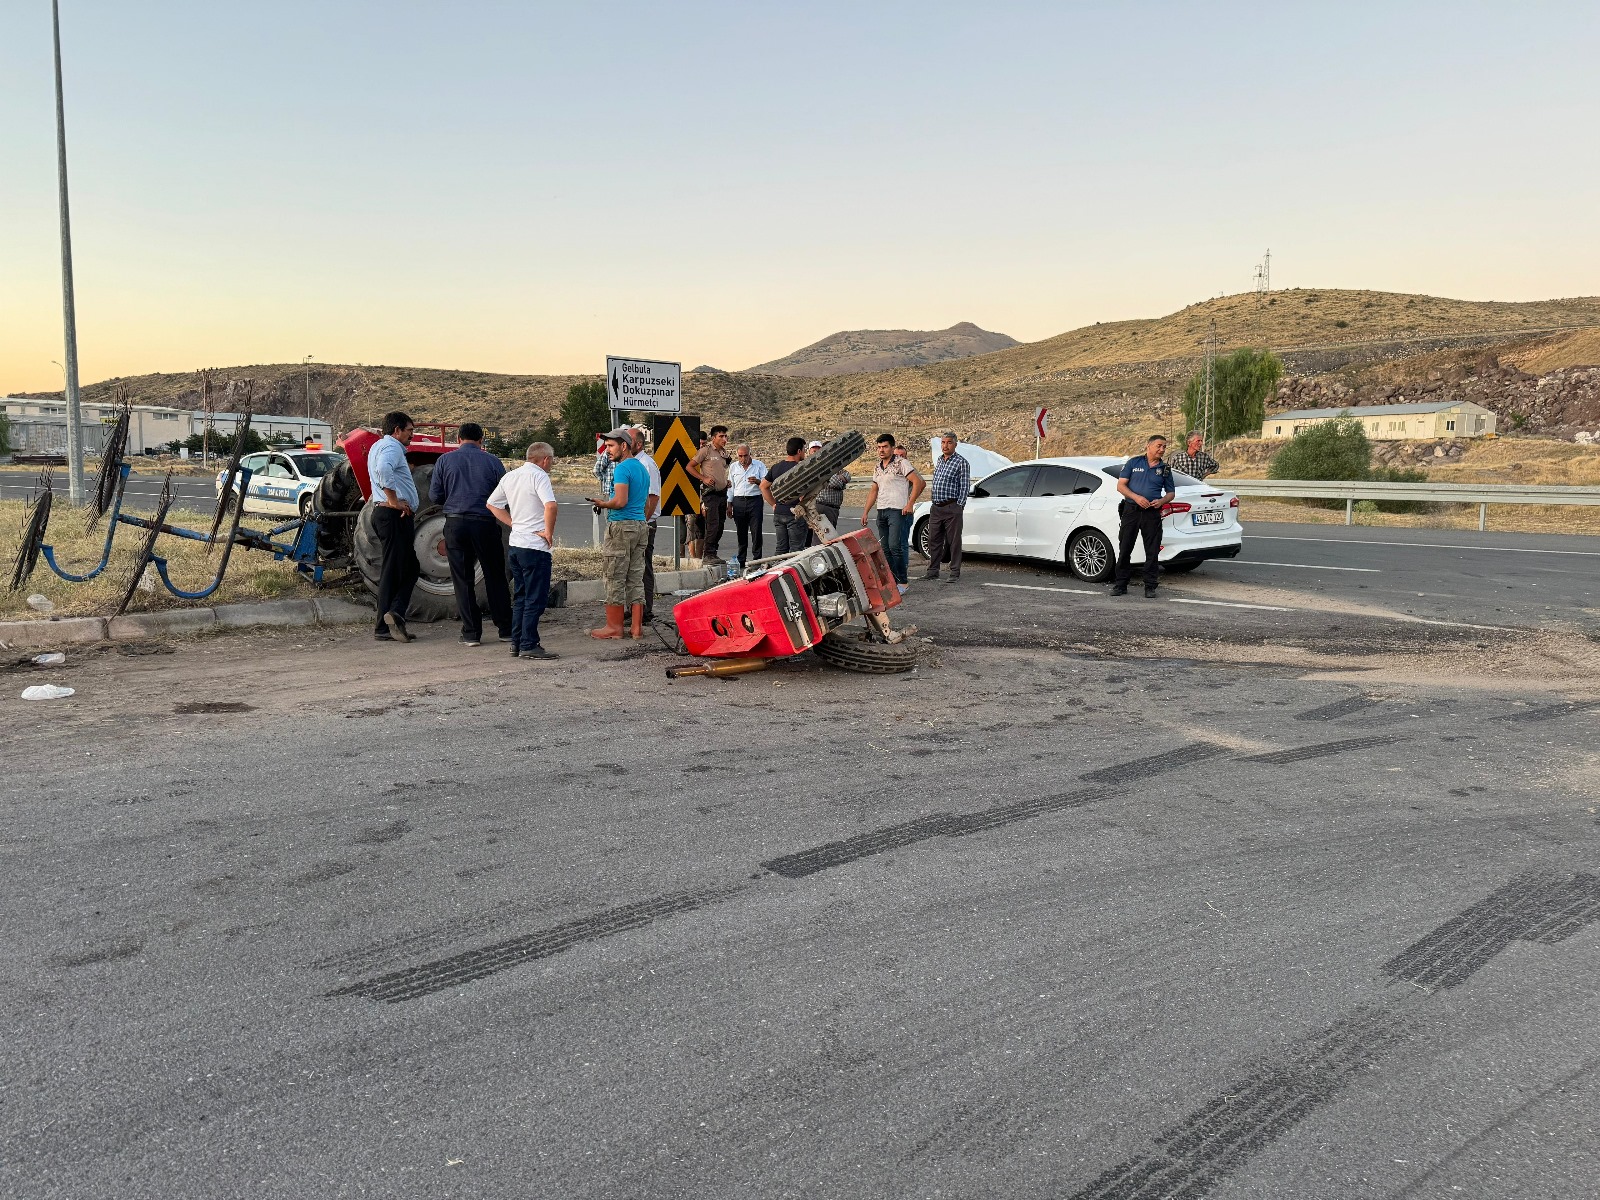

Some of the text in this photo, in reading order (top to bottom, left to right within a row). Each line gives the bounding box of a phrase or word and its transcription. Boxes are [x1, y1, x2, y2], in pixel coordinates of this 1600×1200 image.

[622, 363, 651, 374] Gelbula
[622, 374, 675, 387] Karpuzseki
[622, 385, 675, 398] Dokuzpınar
[623, 397, 659, 408] Hürmetçi
